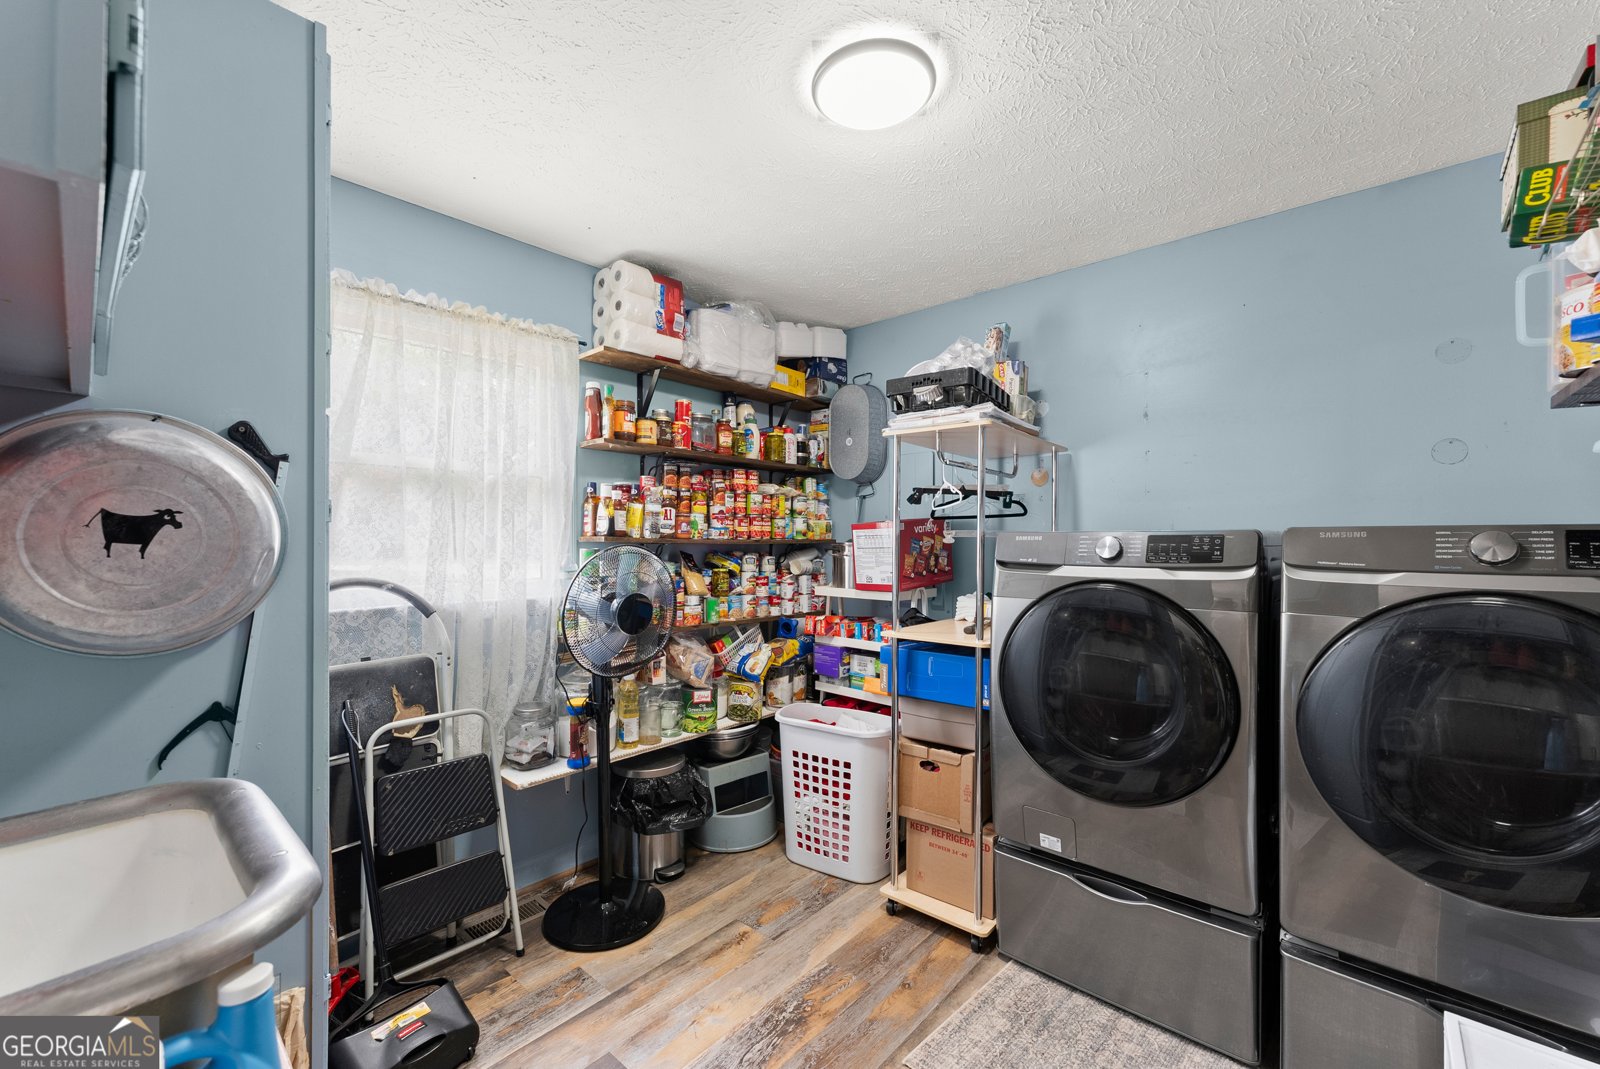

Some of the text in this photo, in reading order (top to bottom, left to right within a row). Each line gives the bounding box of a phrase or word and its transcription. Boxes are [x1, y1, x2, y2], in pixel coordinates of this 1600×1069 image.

[1523, 167, 1554, 207] CLUB
[910, 821, 991, 853] KEEP REFRIGERAED
[928, 841, 951, 853] BETWEEN
